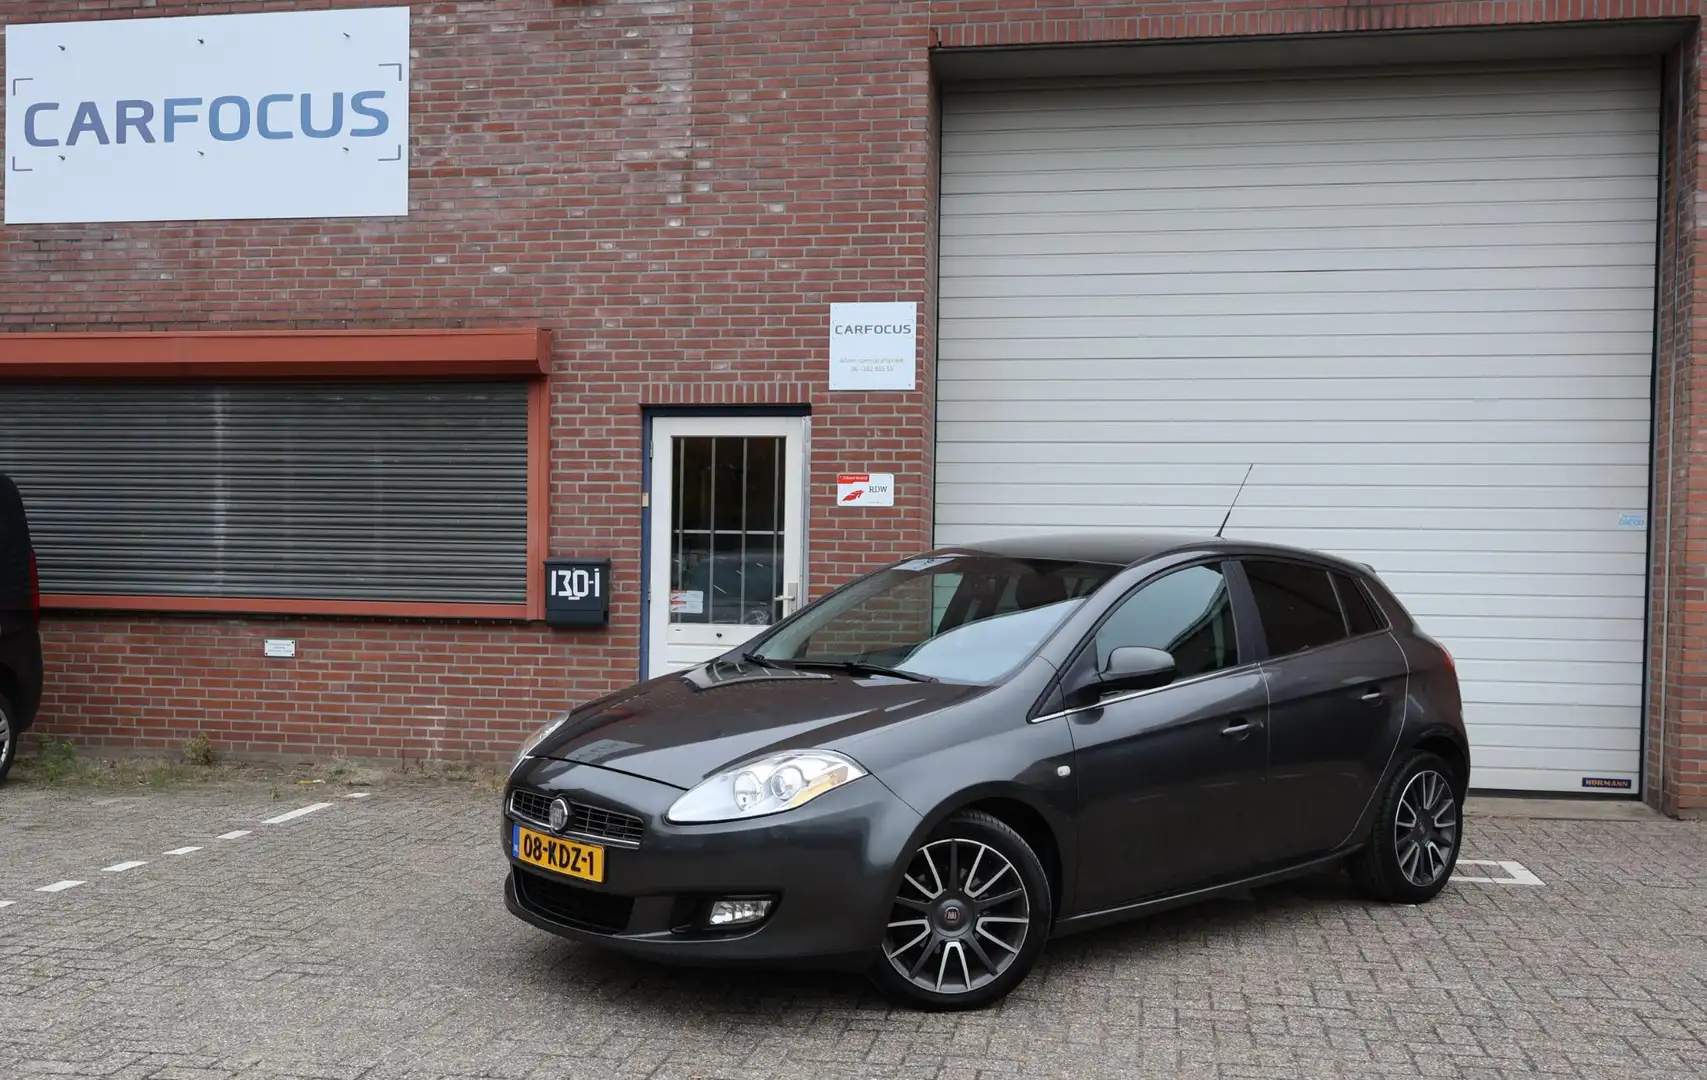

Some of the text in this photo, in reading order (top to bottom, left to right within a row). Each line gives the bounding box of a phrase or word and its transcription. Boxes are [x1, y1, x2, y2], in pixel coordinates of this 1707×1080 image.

[24, 90, 389, 147] CARFOCUS
[835, 324, 911, 334] CARFOCUS
[869, 485, 888, 493] RDW
[523, 834, 594, 876] 08-KDZ-1
